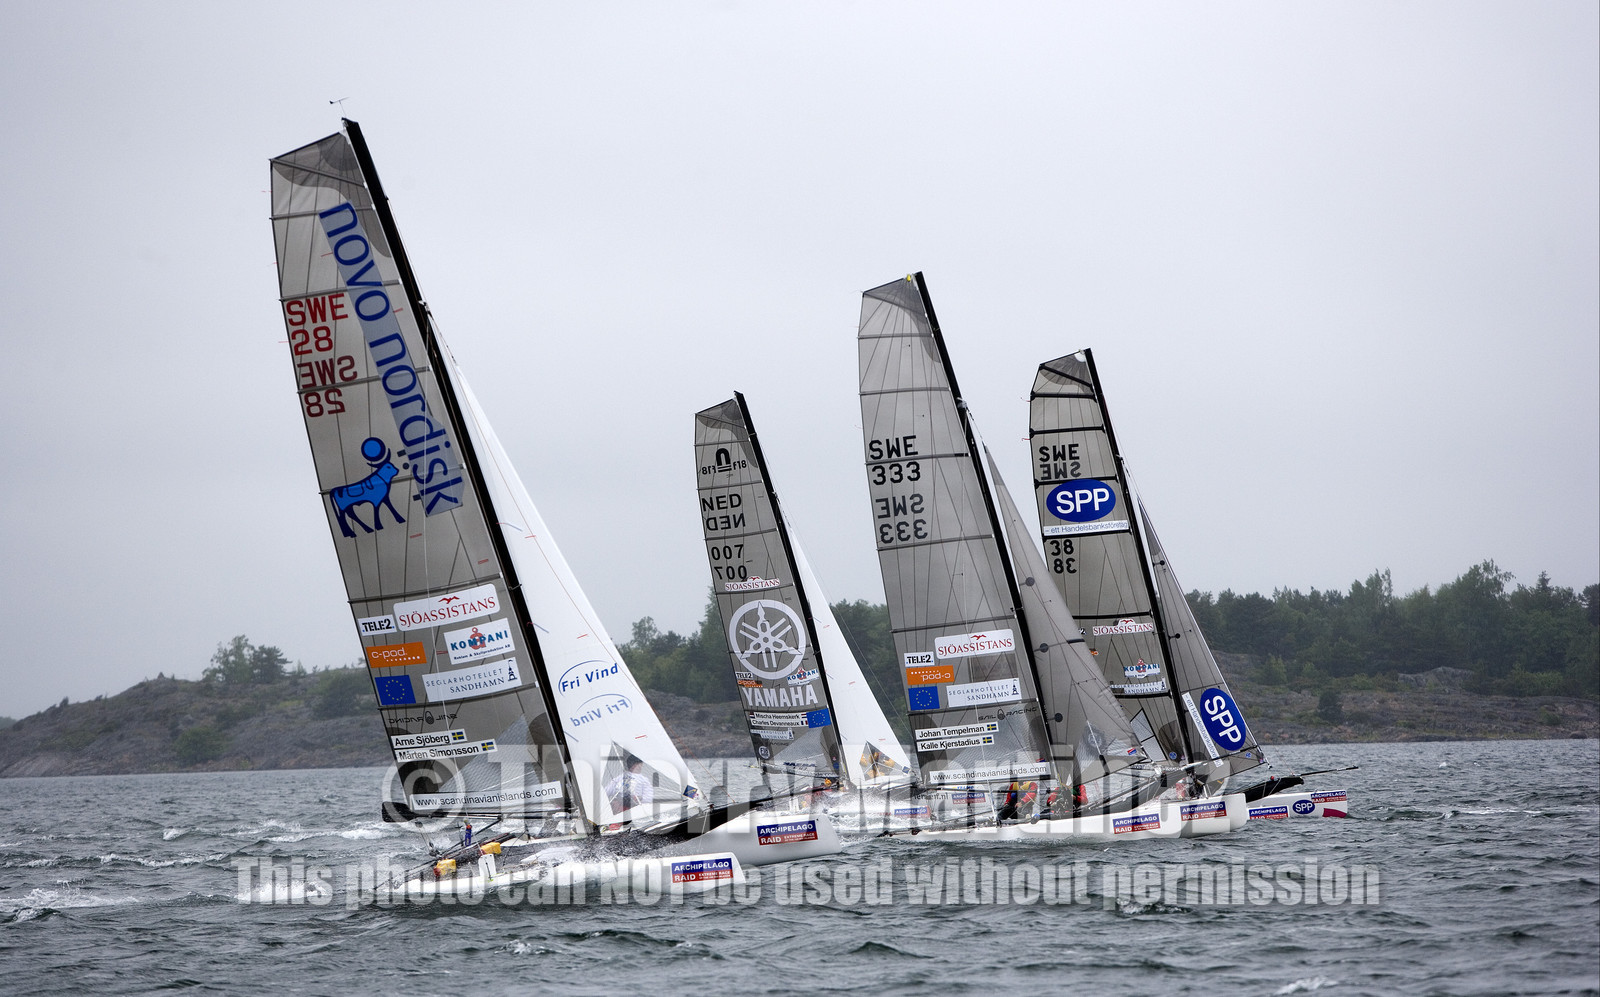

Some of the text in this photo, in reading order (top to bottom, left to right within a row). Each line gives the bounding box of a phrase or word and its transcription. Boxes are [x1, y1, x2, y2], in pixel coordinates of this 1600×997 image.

[286, 293, 348, 326] SWE
[291, 326, 333, 356] 28
[318, 202, 463, 515] novo nordisk
[869, 435, 918, 460] SWE
[1039, 443, 1079, 462] SWE
[872, 461, 920, 485] 333
[701, 493, 742, 511] NED
[1056, 487, 1110, 514] SPP
[711, 544, 744, 560] 007
[1050, 539, 1074, 556] 38
[399, 597, 496, 627] SJÖASSISTANS
[450, 630, 508, 651] KOMPANI
[938, 638, 1012, 656] SJÖASSISTANS
[787, 670, 818, 680] KOMPANI
[1124, 664, 1160, 672] KOMPANI
[426, 669, 503, 687] SEGLARHOTELLET
[450, 677, 505, 693] SANDHAMN
[561, 663, 619, 692] Fri Vind
[742, 684, 818, 708] YAMAHA
[949, 684, 1009, 695] SEGLARHOTELLET
[967, 690, 1010, 701] SANDHAMN
[1204, 695, 1242, 743] SPP
[919, 725, 985, 738] Johan Tempelman
[395, 735, 450, 746] Arne Sjöberg
[939, 739, 980, 749] Kjerstadius
[399, 745, 479, 760] Mårten Simonsson
[932, 765, 1047, 780] www.scandinavianislands.com
[415, 786, 557, 806] www.scandinavianislands.com
[1182, 804, 1224, 812] ARCHIPELAGO
[1295, 803, 1313, 812] SPP
[760, 824, 813, 834] ARCHIPELAGO
[1115, 816, 1158, 825] ARCHIPELAGO
[674, 861, 729, 871] ARCHIPELAGO
